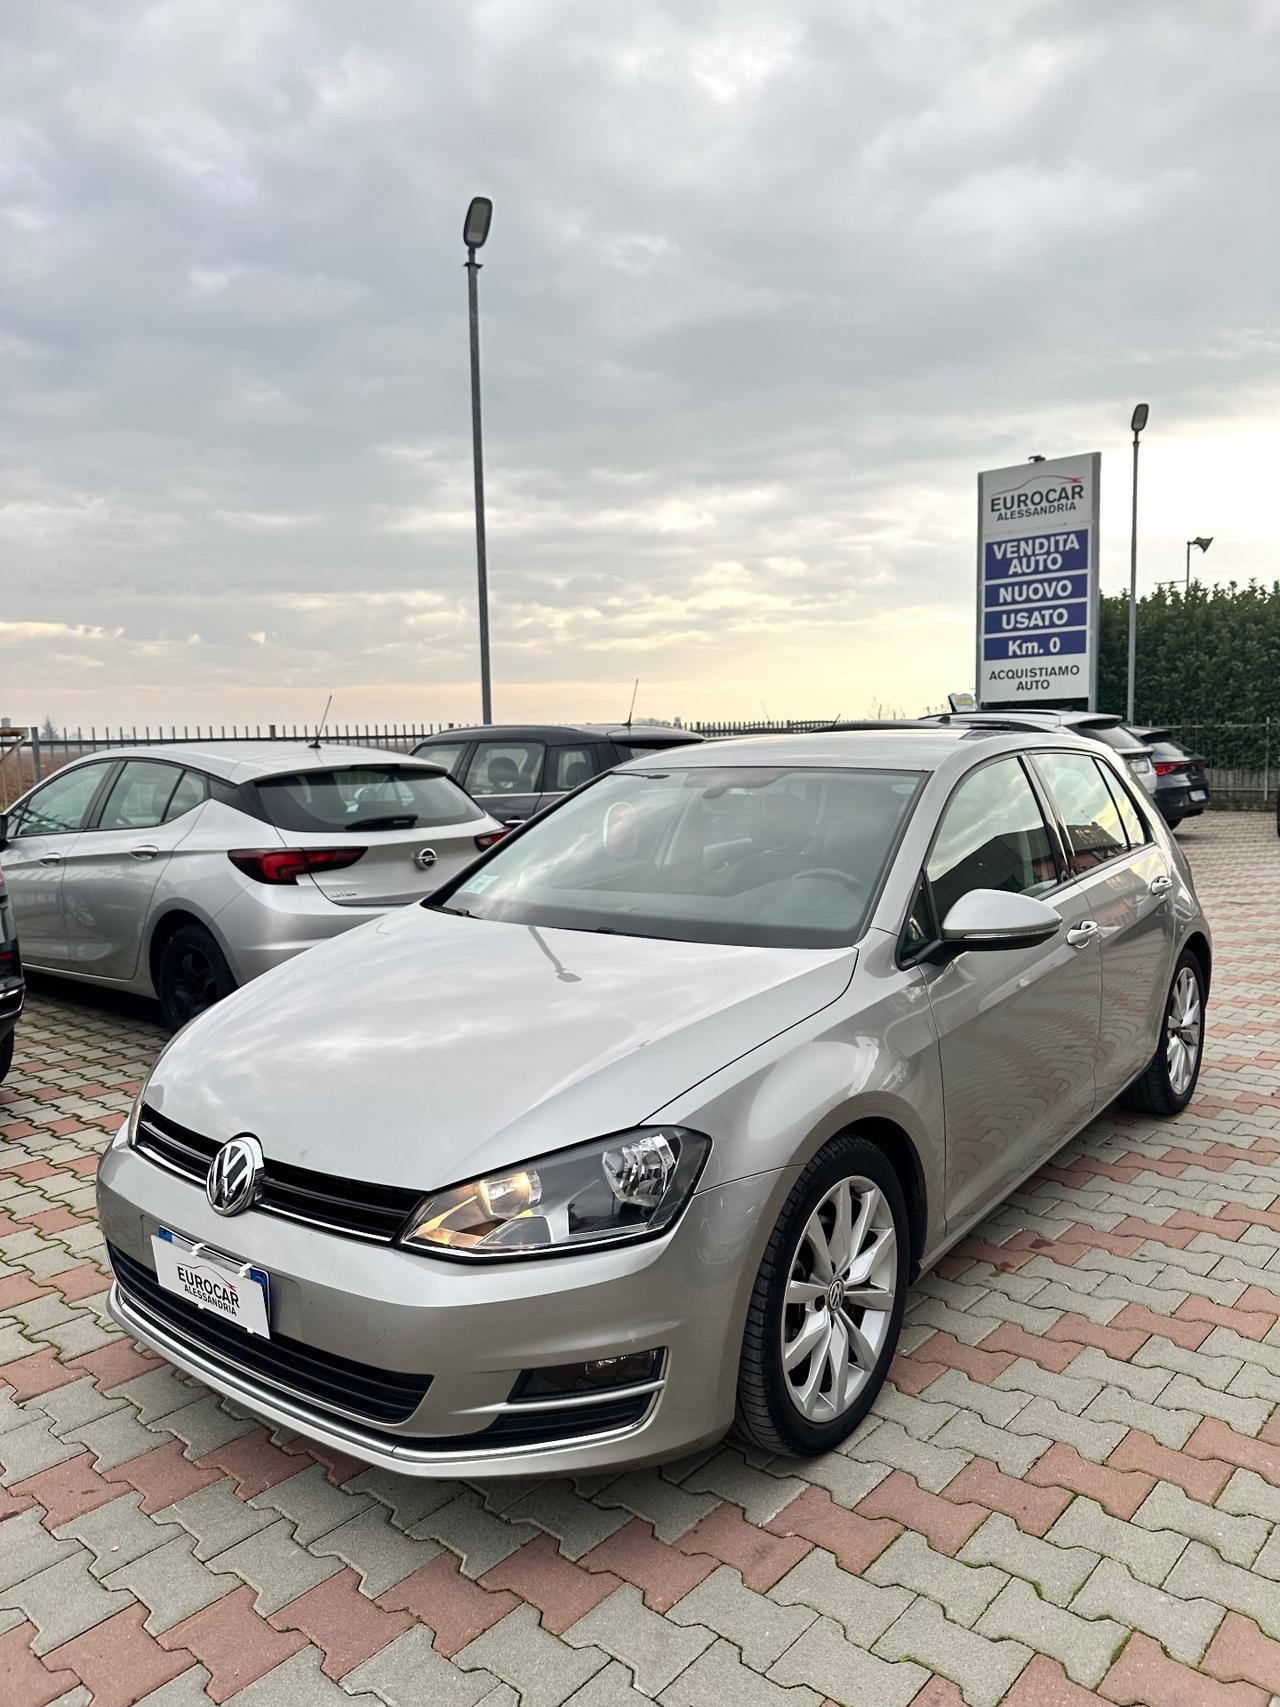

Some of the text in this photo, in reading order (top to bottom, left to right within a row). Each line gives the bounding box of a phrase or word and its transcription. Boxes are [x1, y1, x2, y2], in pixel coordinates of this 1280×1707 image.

[990, 484, 1084, 512] EUROCAR
[996, 502, 1077, 521] ALESSANDRIA
[992, 533, 1080, 560] VENDITA
[1008, 553, 1063, 575] AUTO
[999, 580, 1073, 604] NUOVO
[1001, 608, 1069, 630] USATO
[1008, 636, 1061, 656] Km. 0
[989, 664, 1080, 681] ACQUISTIAMO
[1016, 679, 1051, 692] AUTO
[177, 1266, 240, 1309] EUROCAR
[184, 1285, 237, 1316] ALESSANDRIA
